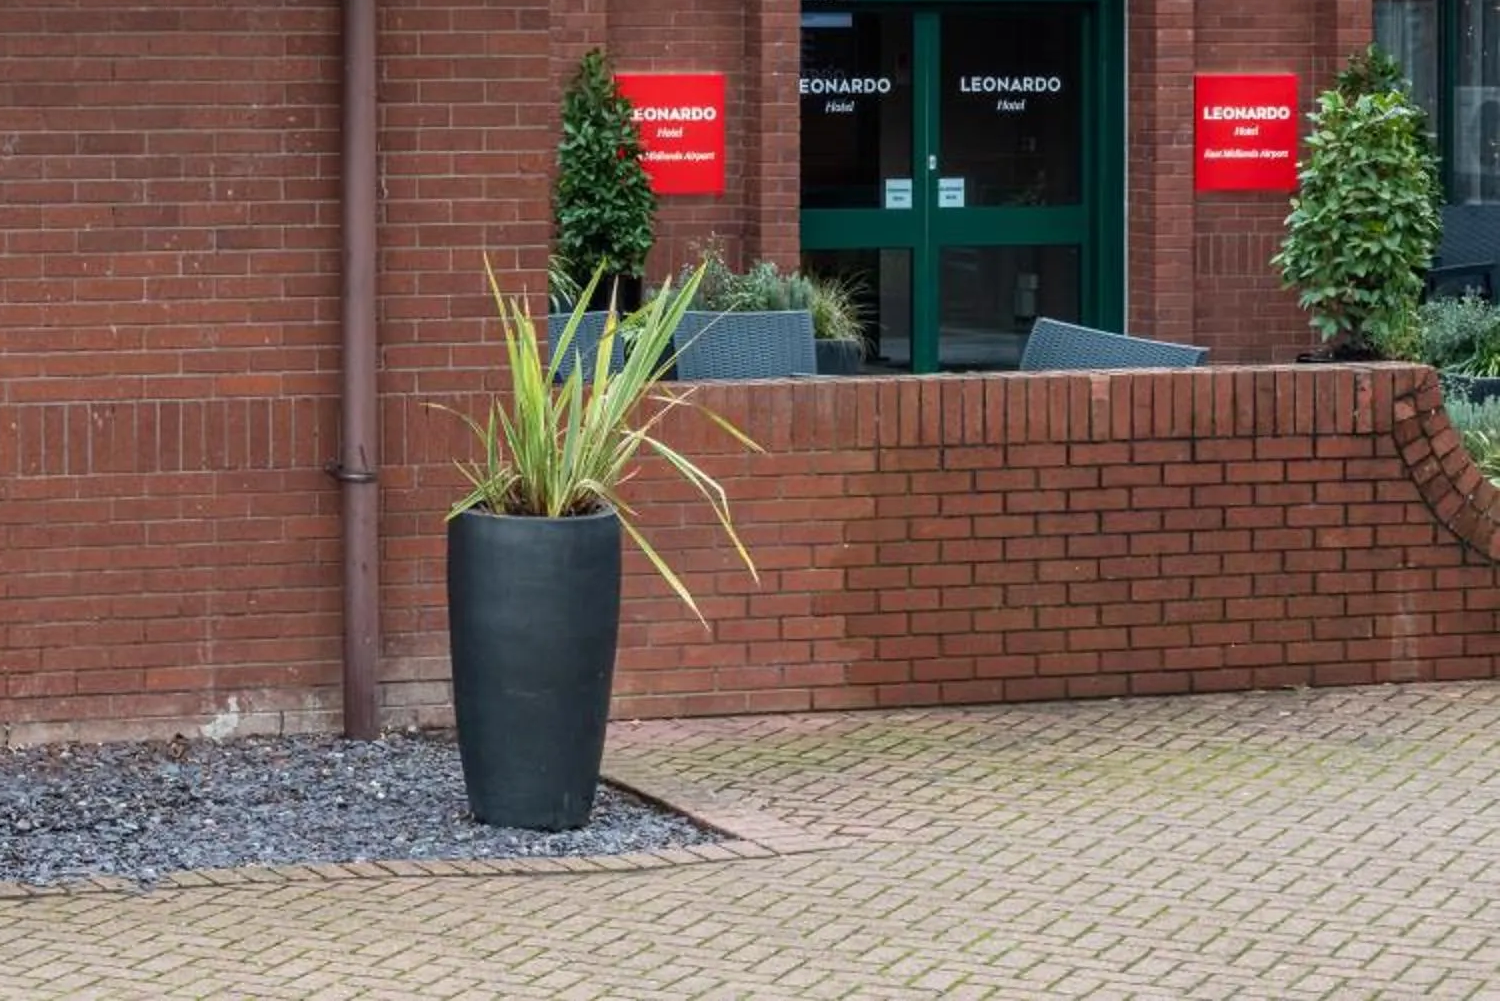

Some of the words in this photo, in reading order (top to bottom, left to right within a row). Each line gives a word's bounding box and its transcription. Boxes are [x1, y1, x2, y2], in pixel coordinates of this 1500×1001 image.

[799, 78, 891, 94] EONARDO
[960, 76, 1061, 92] LEONARDO
[630, 107, 717, 120] EONARDO
[825, 100, 855, 114] Hotel
[1203, 106, 1291, 120] LEONARDO
